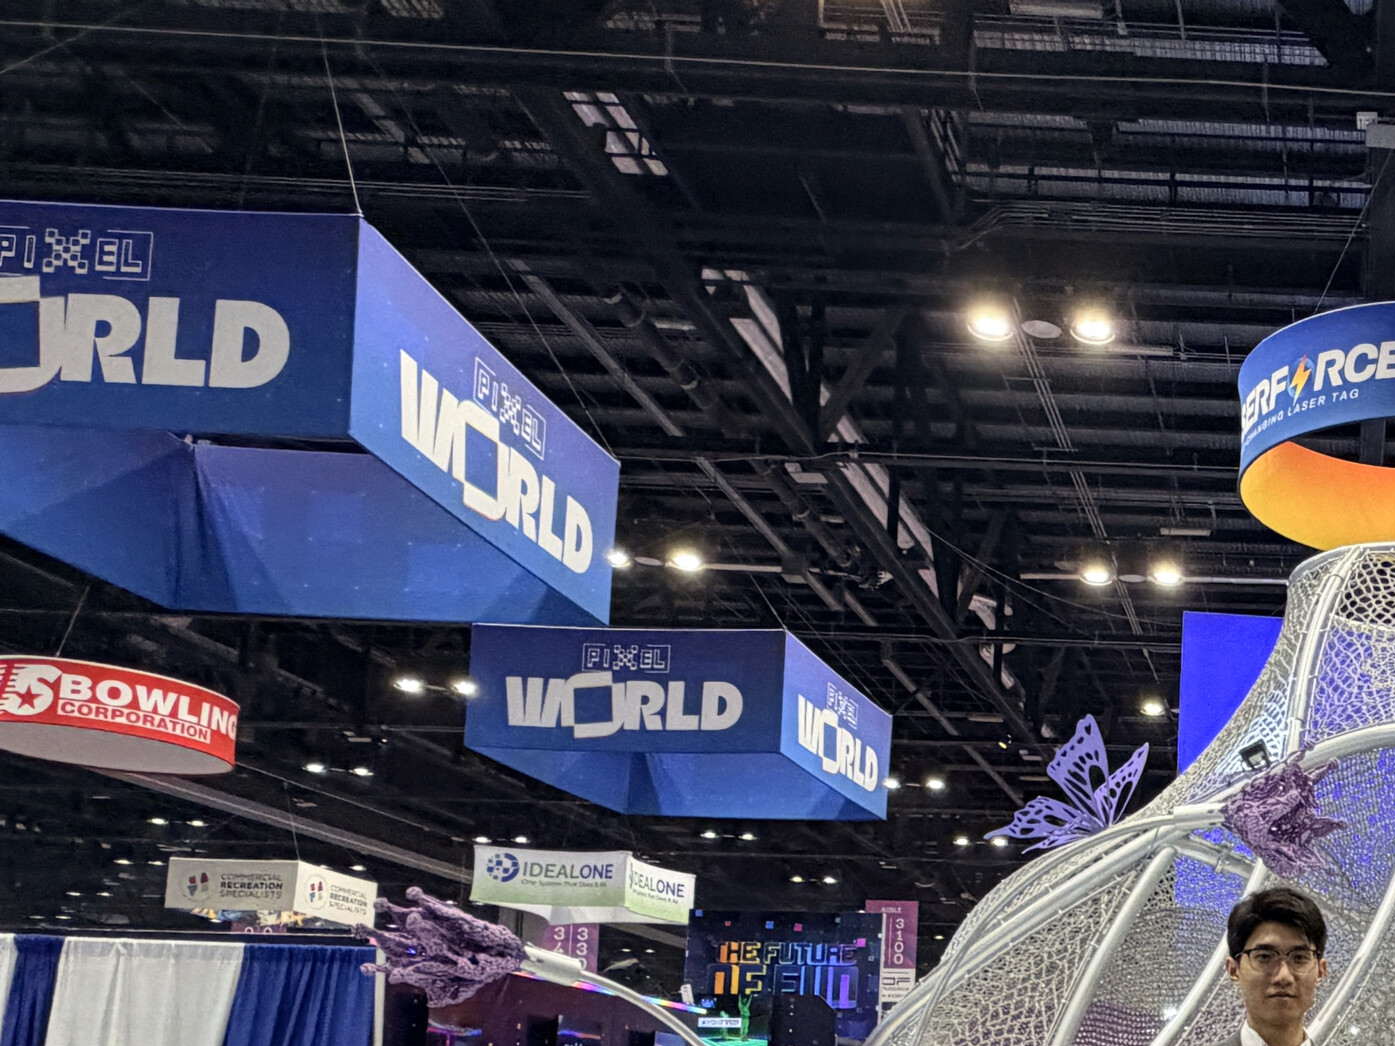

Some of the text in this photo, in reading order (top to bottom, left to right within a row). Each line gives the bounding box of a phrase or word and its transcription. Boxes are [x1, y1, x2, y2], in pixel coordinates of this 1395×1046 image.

[0, 228, 143, 275] PIXEL
[477, 368, 543, 452] PIXEL
[1287, 395, 1327, 417] LASER
[1331, 388, 1360, 403] TAG
[400, 348, 594, 575] WORLD
[586, 644, 667, 671] PIXEL
[59, 672, 238, 742] BOWLING
[60, 700, 209, 742] CORPORATION
[505, 670, 744, 740] WORLD
[798, 693, 879, 793] WORLD
[220, 872, 283, 882] COMMERCIAL
[220, 881, 283, 890] RECREATION
[522, 861, 614, 880] IDEALONE
[219, 889, 282, 900] SPECIALISTS
[893, 917, 905, 965] 3100
